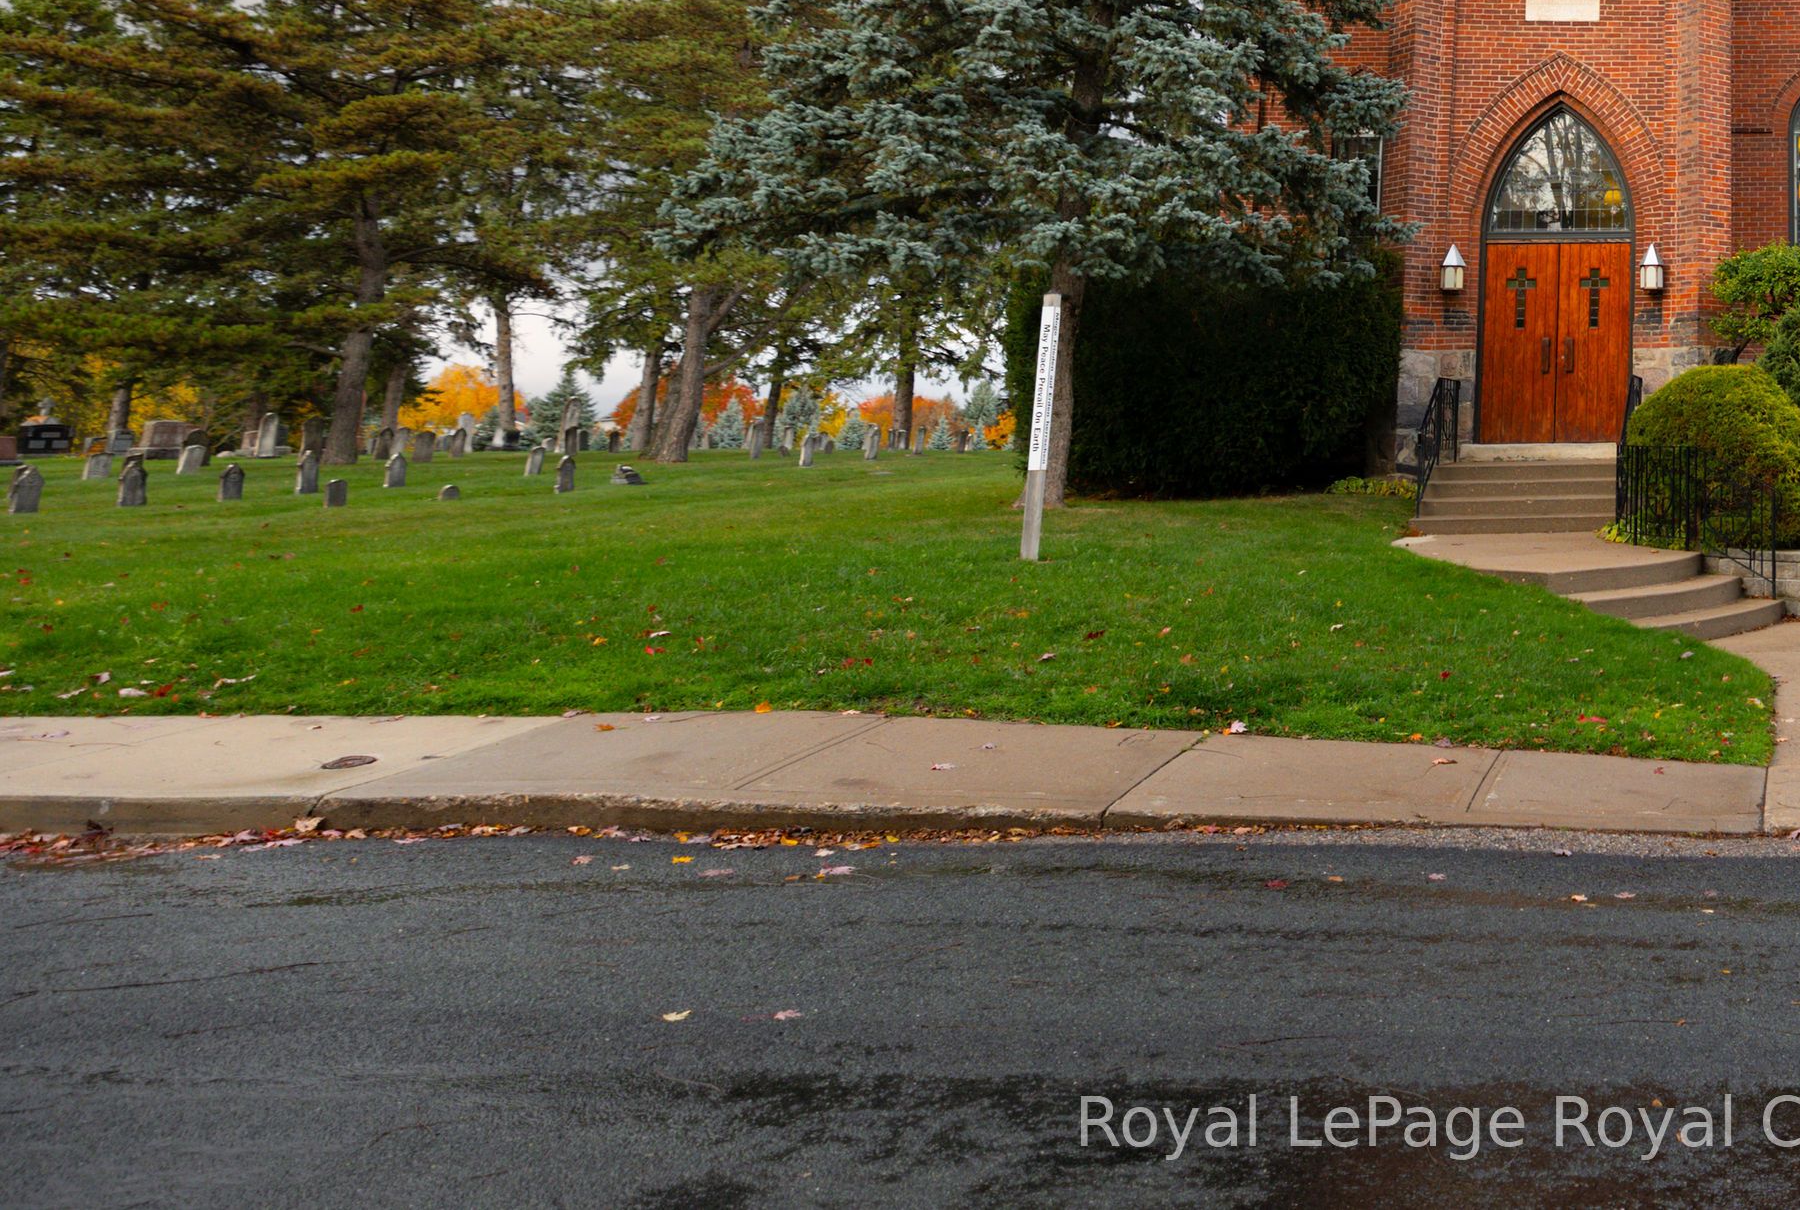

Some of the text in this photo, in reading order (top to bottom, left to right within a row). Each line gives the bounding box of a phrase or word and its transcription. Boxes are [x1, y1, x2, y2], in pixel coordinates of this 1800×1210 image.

[1032, 324, 1051, 452] May Peace Prevail On Earth
